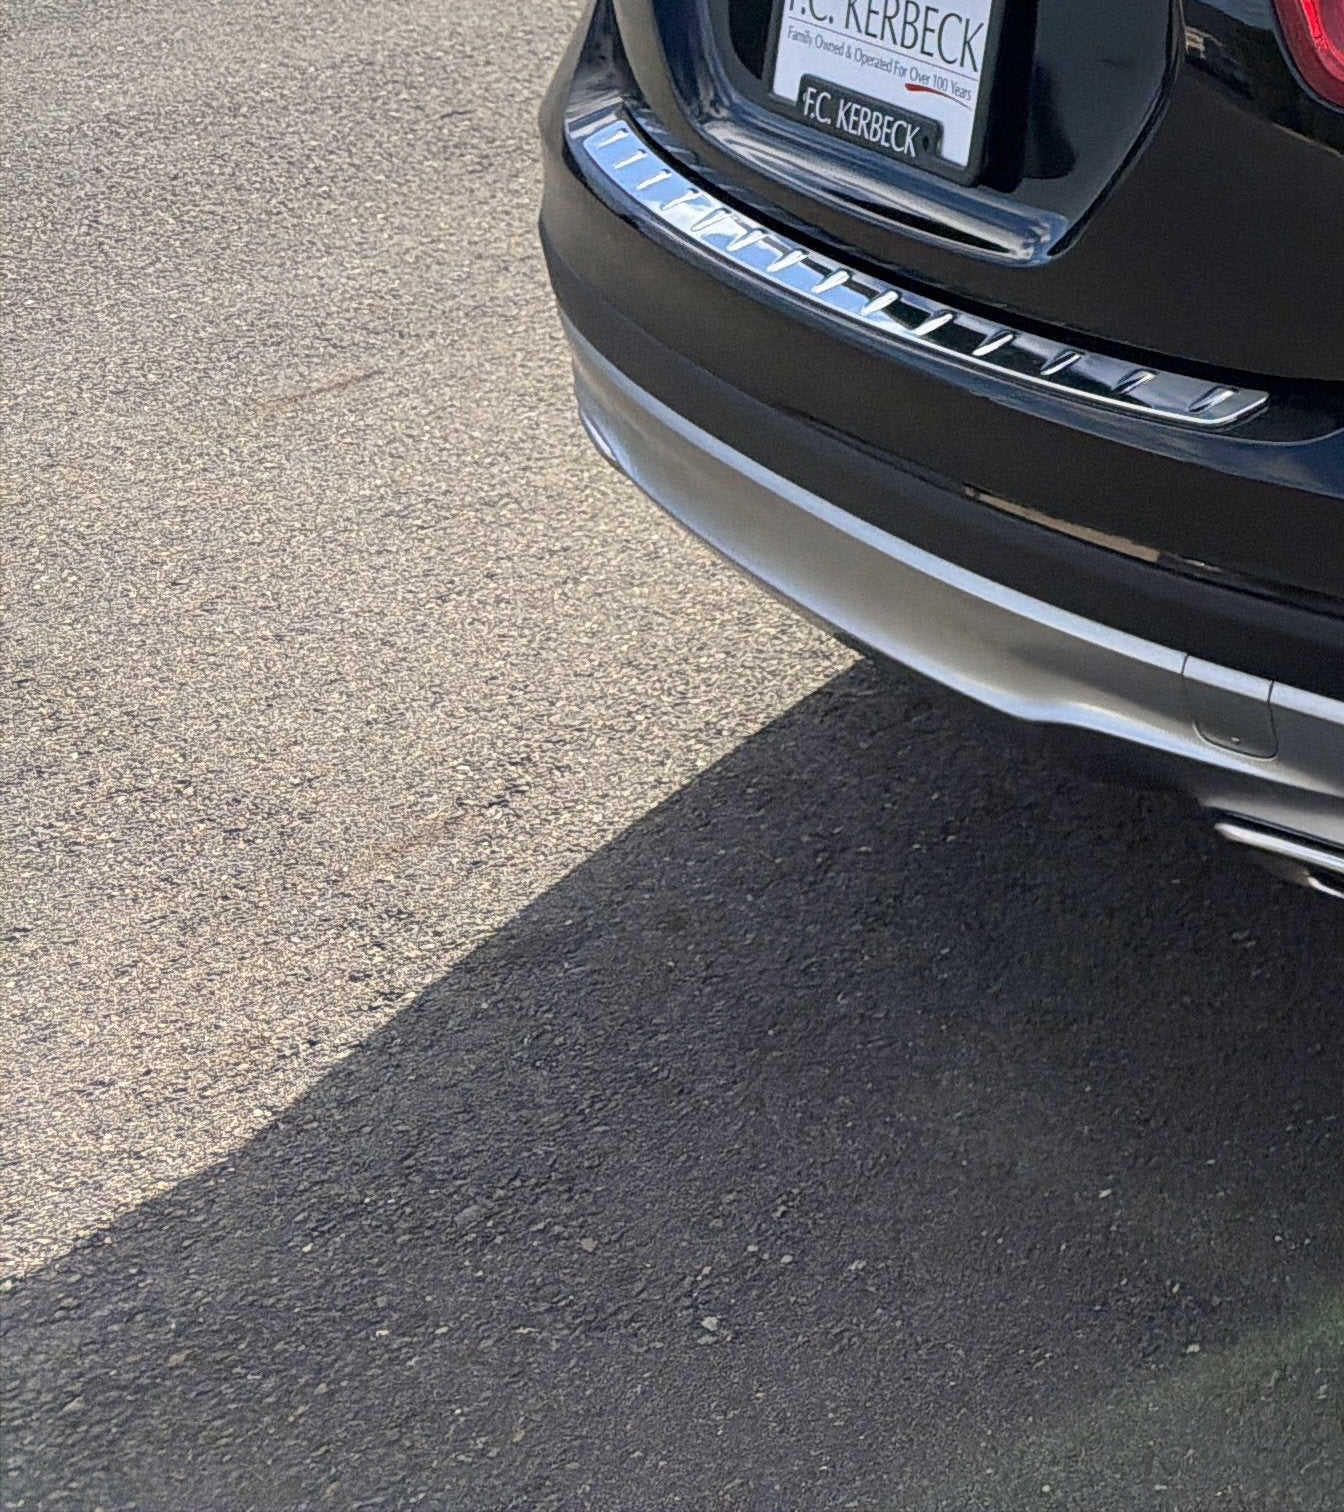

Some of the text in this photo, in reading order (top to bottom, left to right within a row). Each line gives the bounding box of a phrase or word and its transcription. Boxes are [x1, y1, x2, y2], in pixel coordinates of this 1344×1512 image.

[788, 25, 972, 100] Family Owned & Operated For Over 100 Years
[803, 87, 921, 158] F.C. KERBECK
